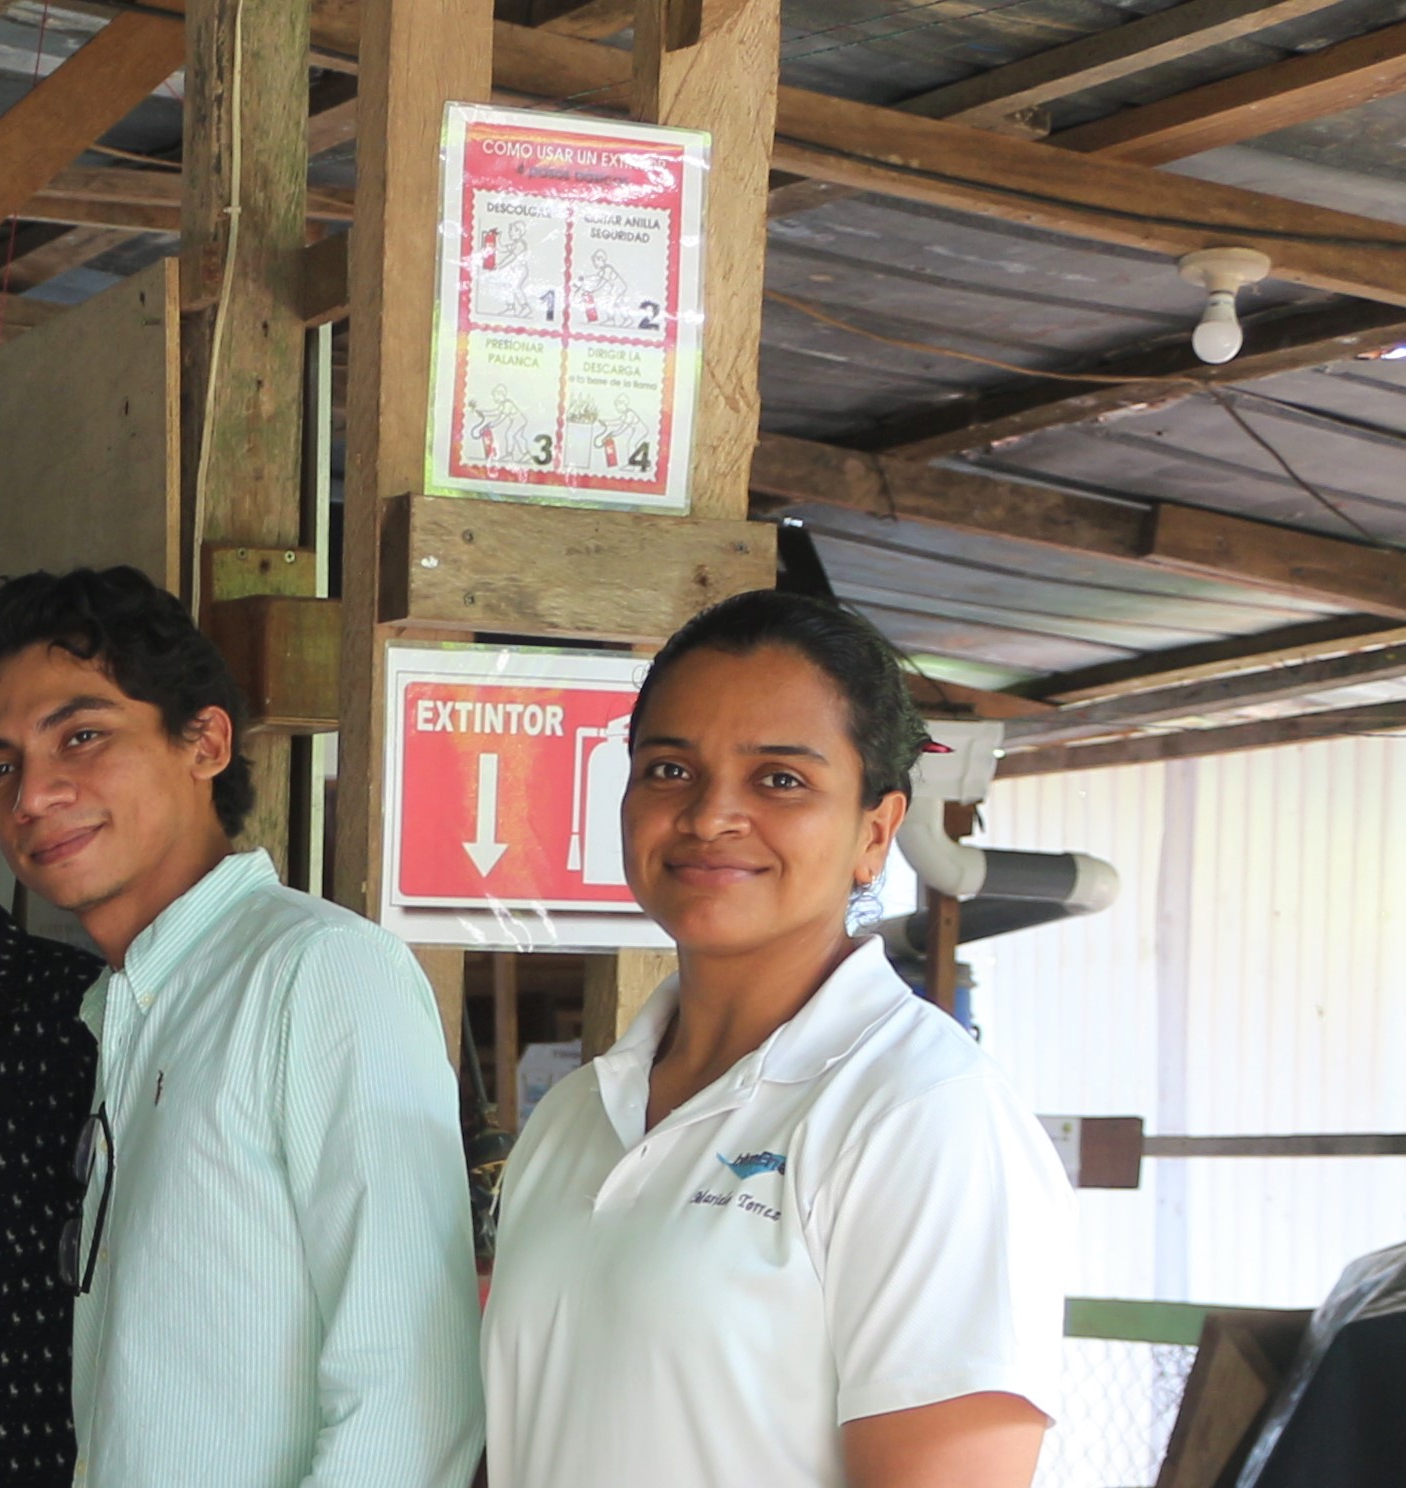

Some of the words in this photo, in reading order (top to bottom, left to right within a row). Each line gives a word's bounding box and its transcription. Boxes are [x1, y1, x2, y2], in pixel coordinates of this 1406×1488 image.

[482, 139, 533, 158] COMO
[537, 145, 573, 163] USAR
[577, 151, 597, 166] UN
[590, 228, 651, 244] SEGURIDAD
[624, 216, 660, 230] ANILLA
[539, 290, 555, 321] 1
[638, 300, 660, 331] 2
[487, 353, 540, 368] PALANCA
[587, 347, 626, 361] DIRIGIR
[628, 351, 641, 362] LA
[583, 362, 641, 378] DESCARGA
[533, 434, 553, 465] 3
[628, 441, 651, 472] 4
[416, 699, 564, 737] EXTINTOR
